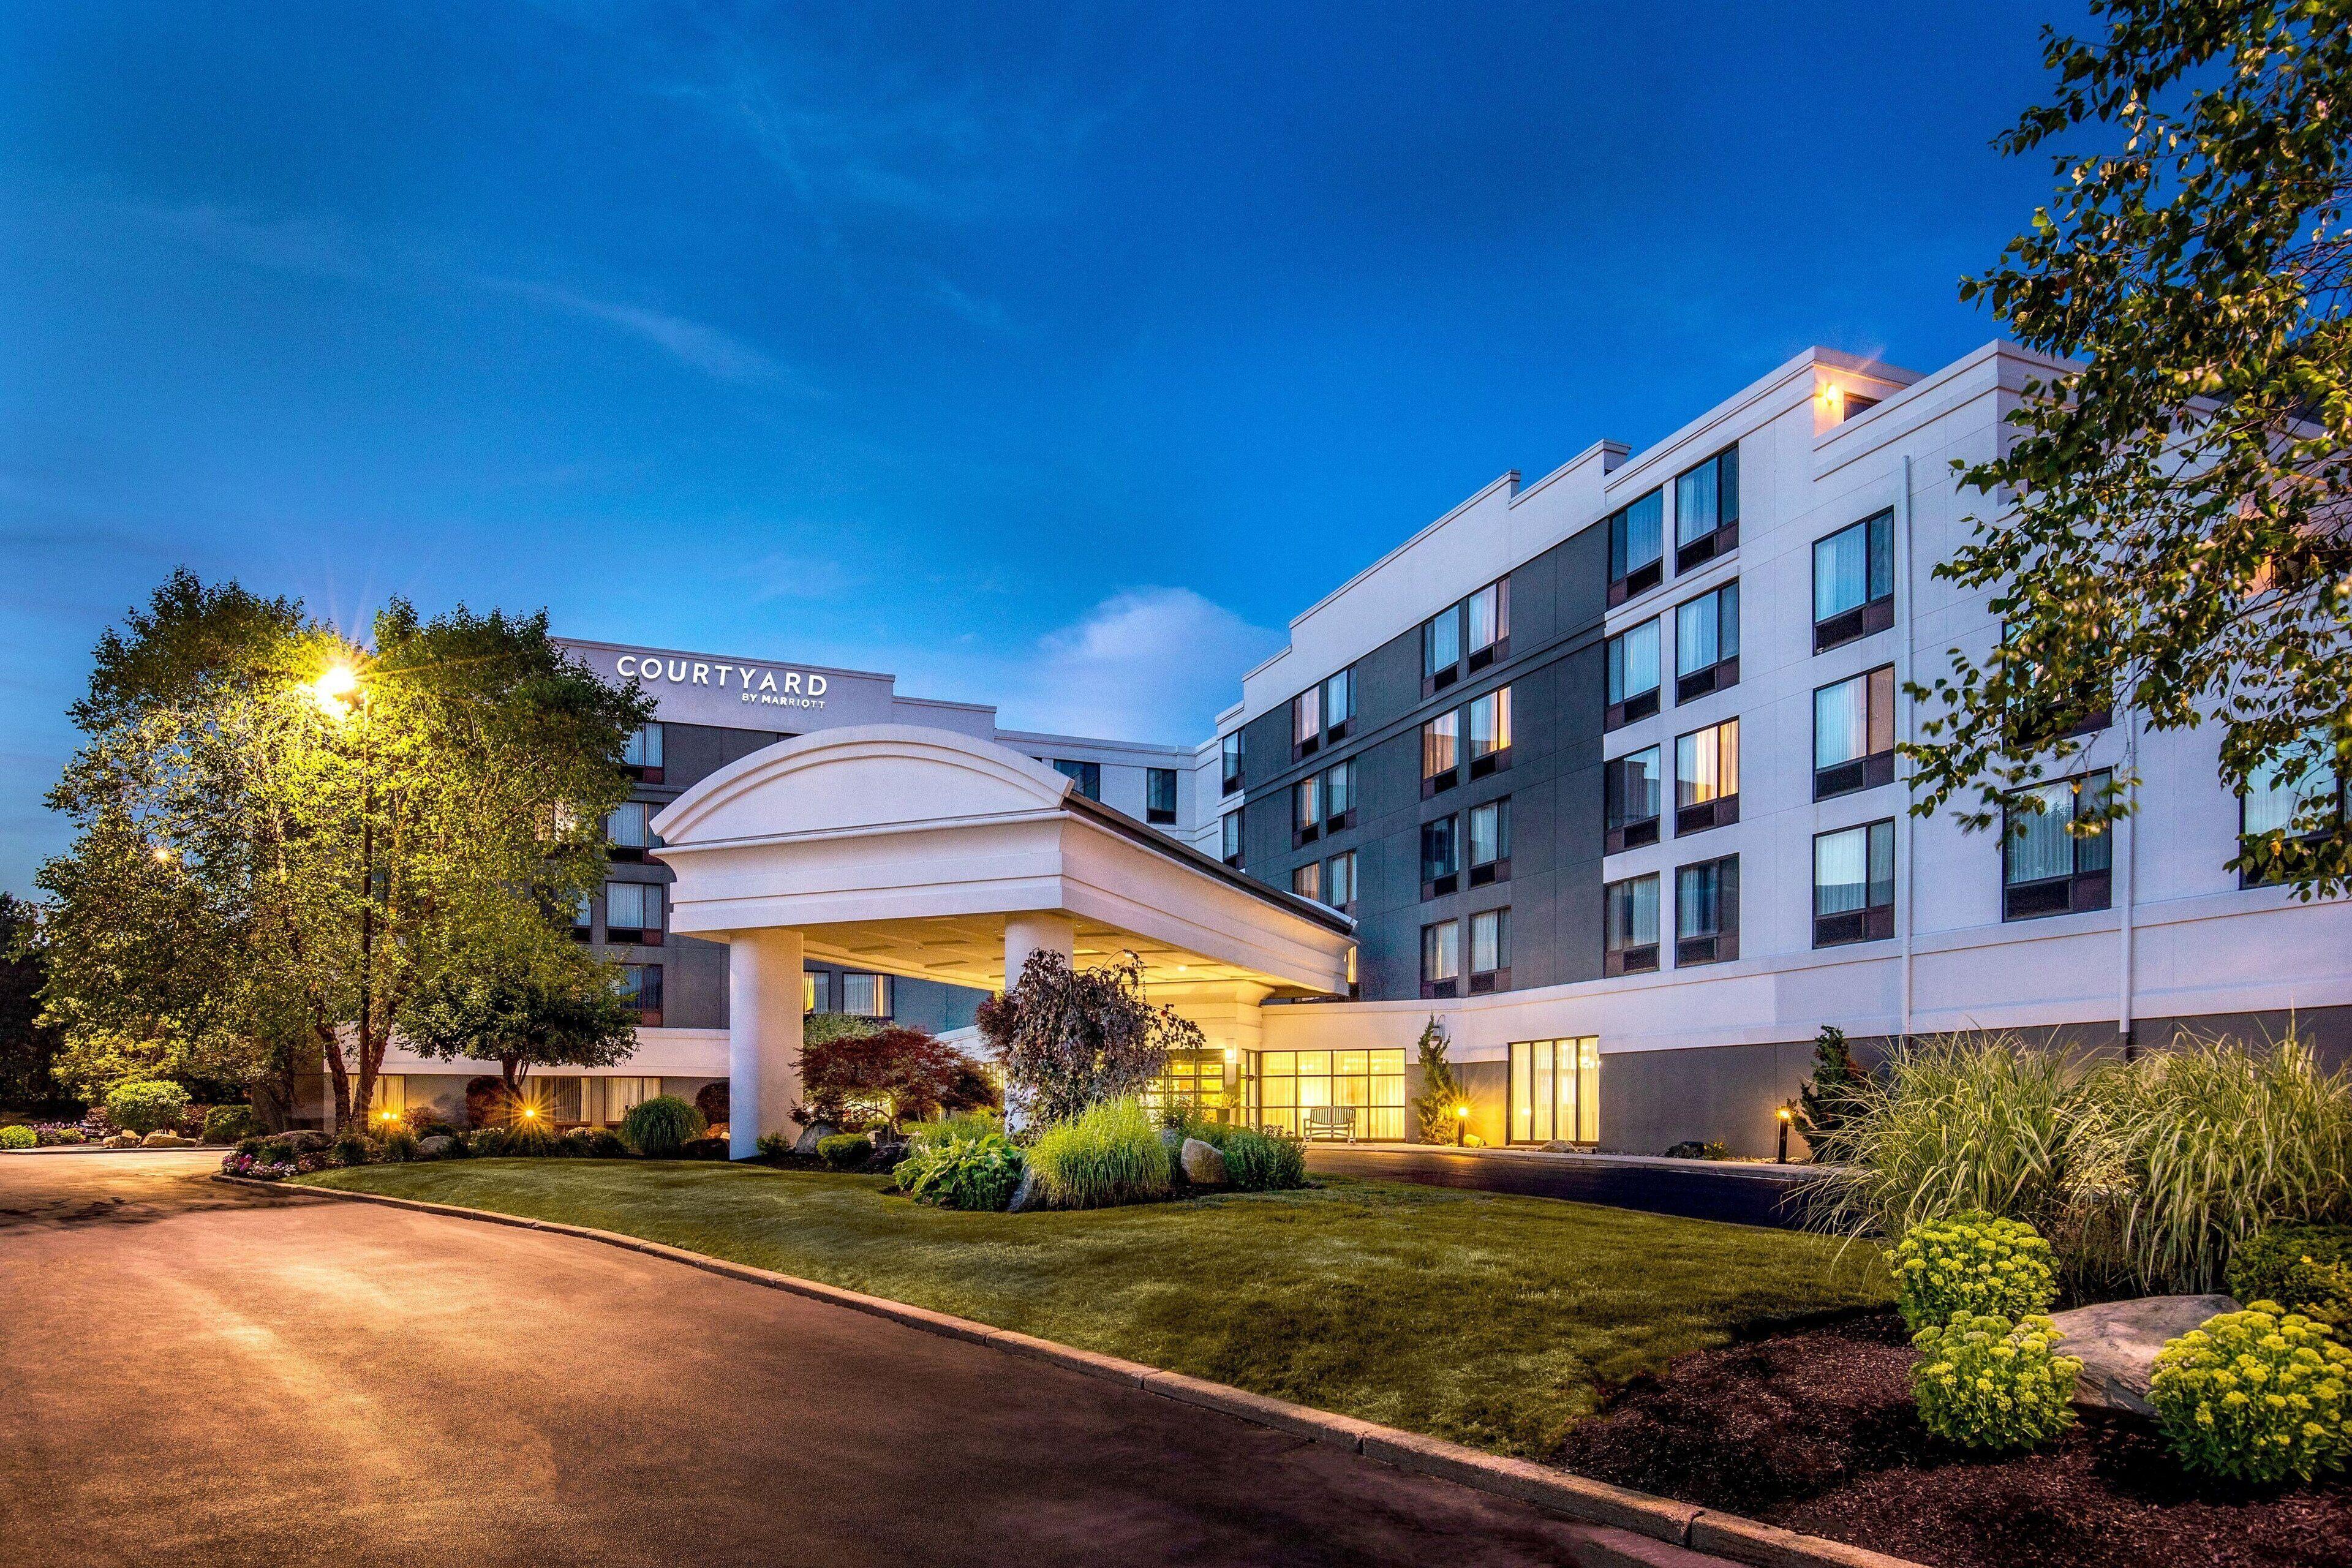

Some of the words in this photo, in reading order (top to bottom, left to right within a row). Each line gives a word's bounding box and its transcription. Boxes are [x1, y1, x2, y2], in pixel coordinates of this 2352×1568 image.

[617, 655, 827, 696] COURTYARD
[742, 693, 758, 703] BY
[762, 695, 825, 709] MARRIOTT
